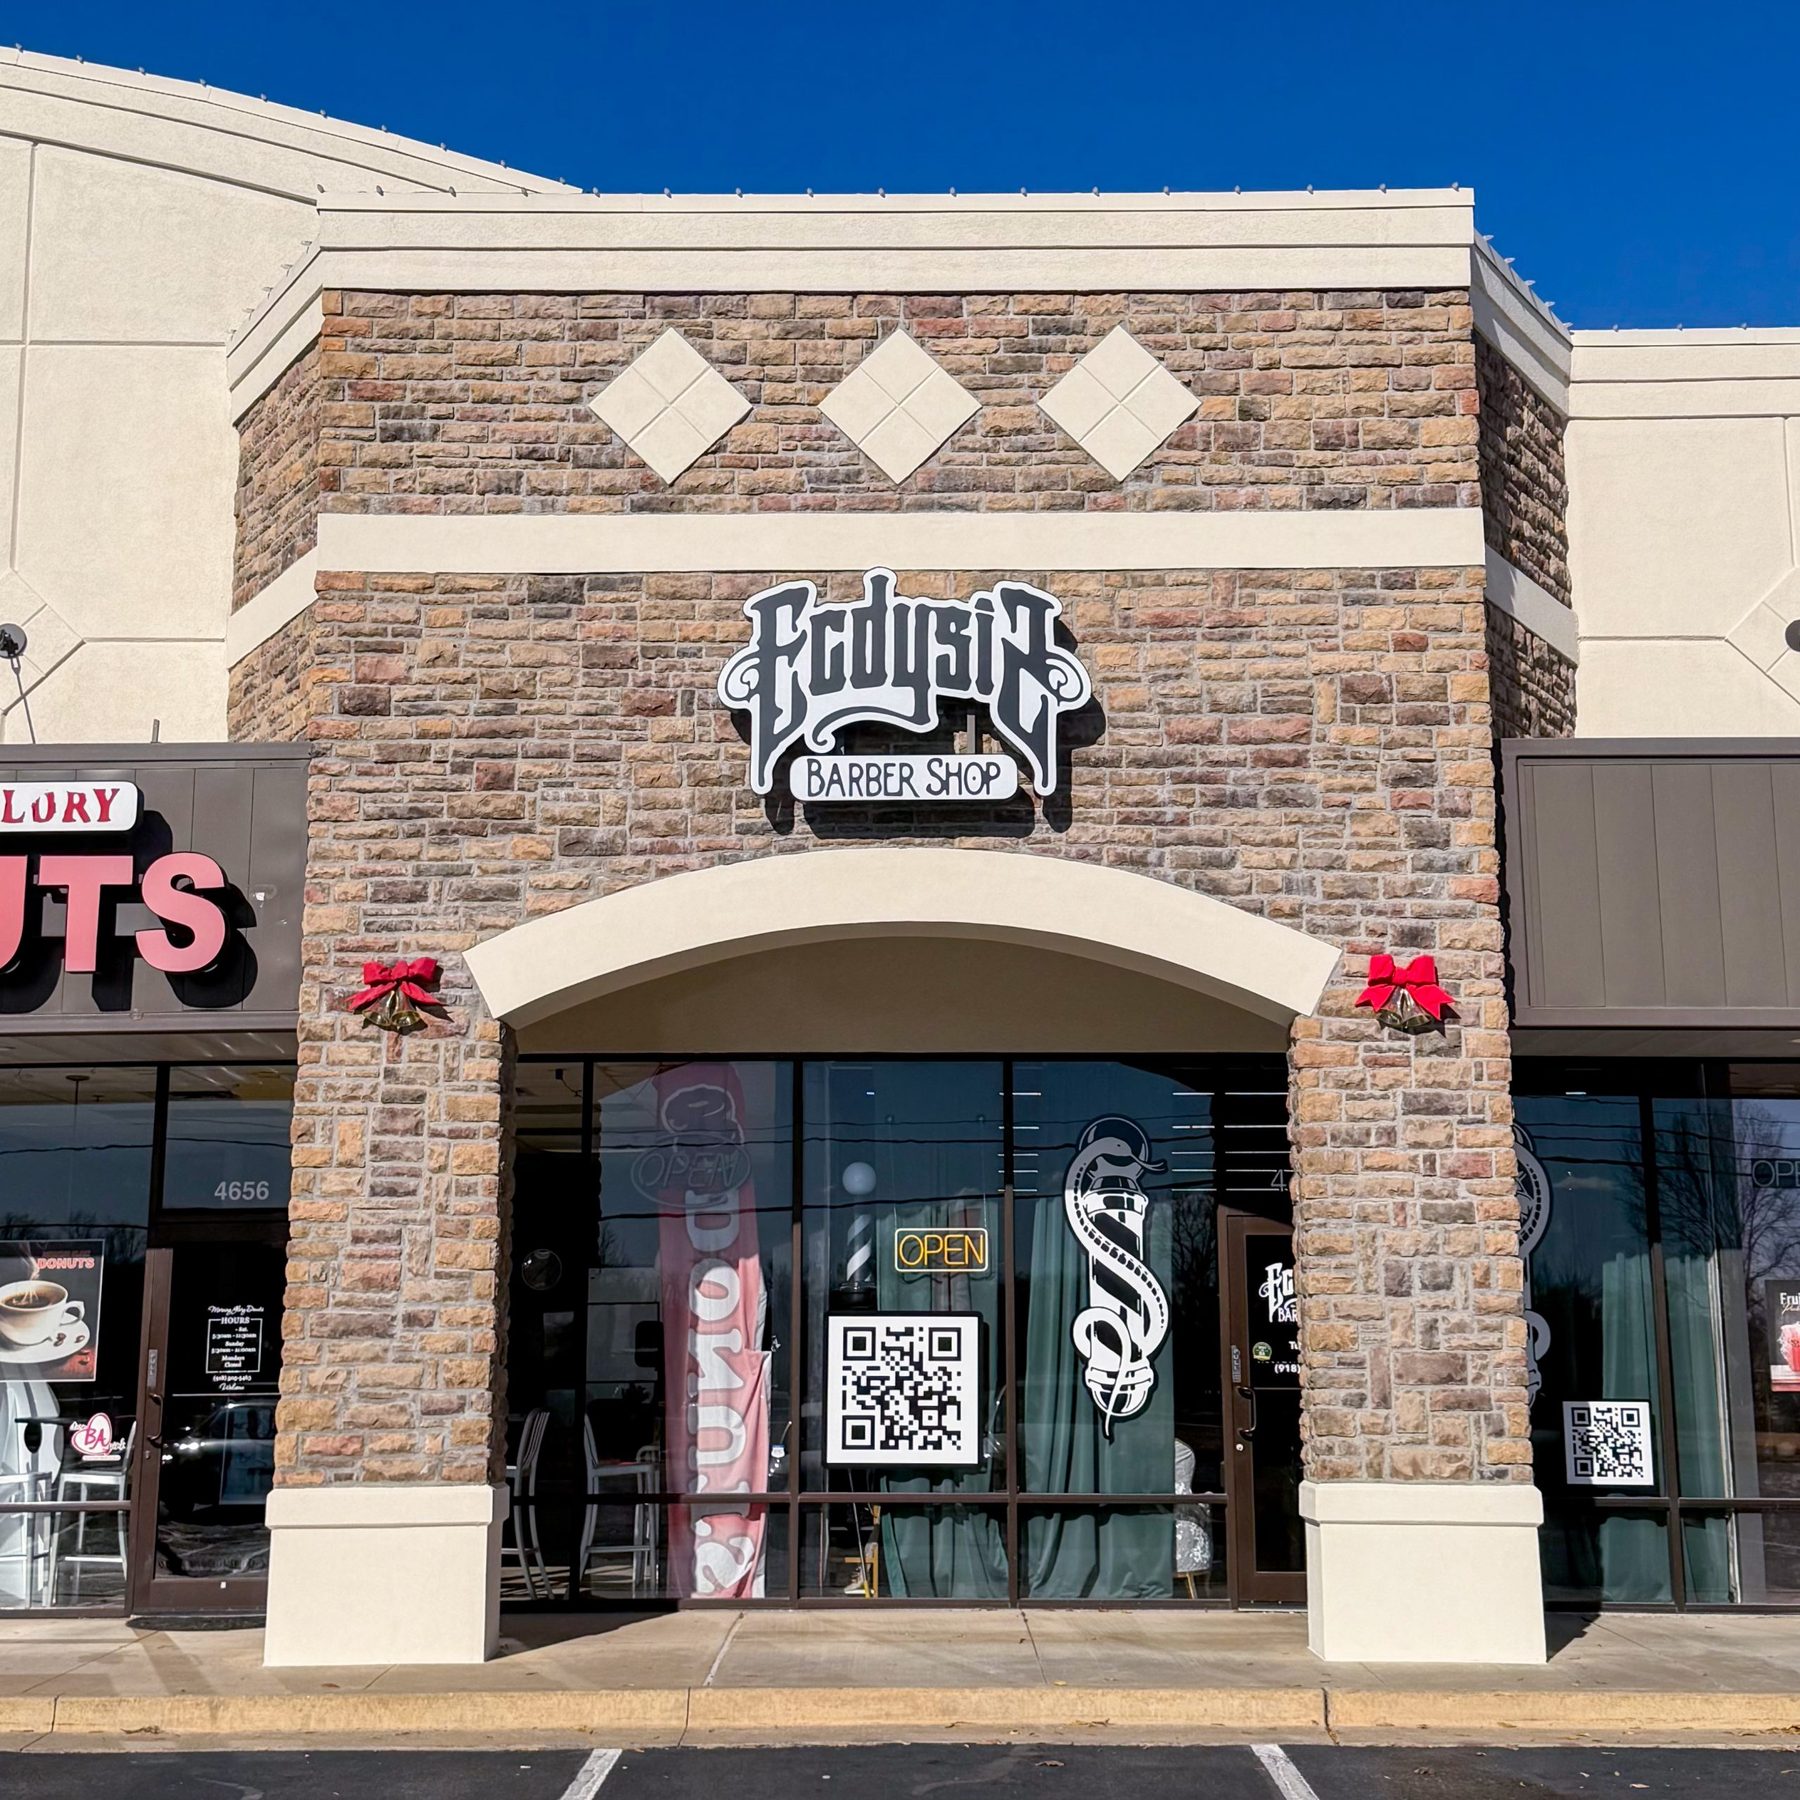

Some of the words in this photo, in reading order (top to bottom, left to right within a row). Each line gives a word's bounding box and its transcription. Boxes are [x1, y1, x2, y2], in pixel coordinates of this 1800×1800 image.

[807, 758, 920, 797] BARBER
[926, 757, 1001, 796] SHOP
[639, 1152, 740, 1188] OPEN
[1271, 1169, 1287, 1191] 4
[214, 1181, 270, 1200] 4656
[899, 1234, 983, 1266] OPEN
[37, 1257, 95, 1270] DONUTS
[221, 1316, 250, 1324] HOURS
[1274, 1363, 1300, 1374] (918)
